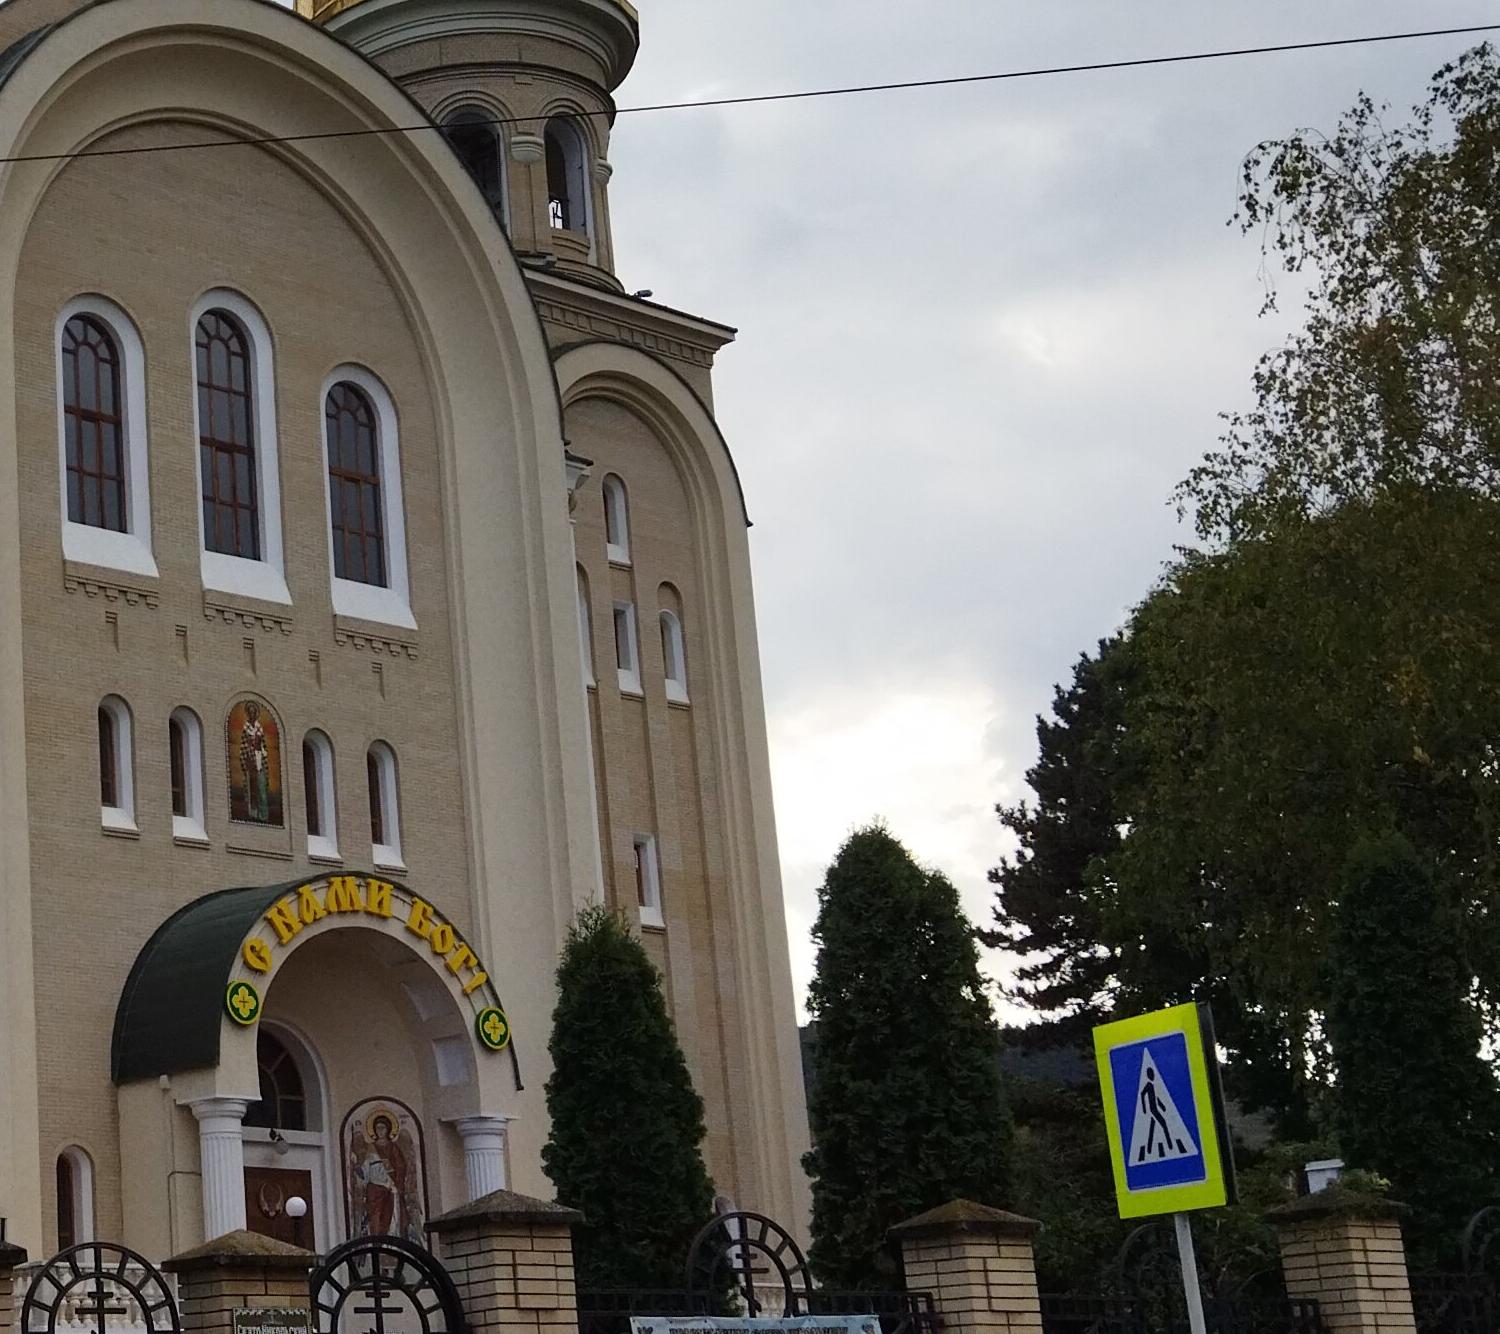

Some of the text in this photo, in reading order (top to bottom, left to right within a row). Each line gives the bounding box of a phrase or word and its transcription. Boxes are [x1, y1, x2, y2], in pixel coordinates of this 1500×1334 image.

[243, 877, 488, 995] С НАМИ БОГ!
